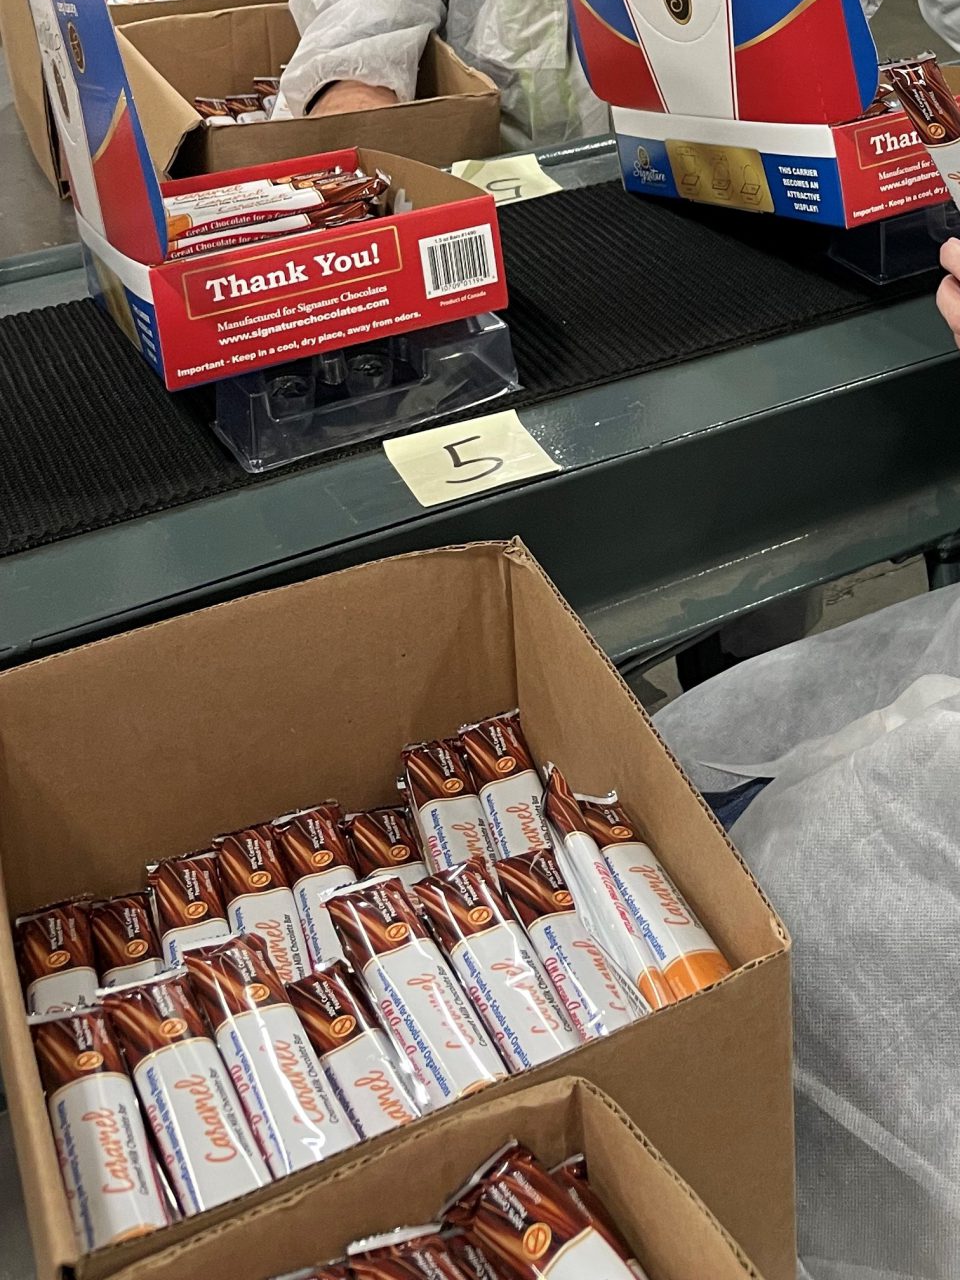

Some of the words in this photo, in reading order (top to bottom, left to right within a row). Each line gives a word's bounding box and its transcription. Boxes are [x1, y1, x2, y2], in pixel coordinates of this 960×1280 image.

[870, 130, 922, 155] Than
[633, 160, 667, 183] Signature
[778, 166, 792, 176] THIS
[792, 167, 818, 178] CARRIER
[782, 179, 810, 188] BECOMES
[810, 180, 819, 189] AN
[878, 164, 921, 180] Manufactured
[921, 161, 930, 169] for
[880, 171, 941, 192] www.signaturec
[786, 190, 821, 202] ATTRACTIVE
[794, 203, 819, 213] DISPLAY!
[853, 204, 885, 218] Important
[888, 198, 905, 208] Keep
[918, 190, 933, 199] cool,
[934, 187, 944, 196] dry
[185, 223, 209, 238] Great
[210, 216, 251, 231] Chocolate
[253, 213, 265, 222] for
[170, 245, 194, 260] Great
[195, 237, 237, 252] Chocolate
[205, 260, 308, 303] Thank
[313, 242, 381, 278] You!
[217, 309, 281, 333] Manufactured
[282, 305, 297, 317] for
[297, 296, 340, 315] Signature
[340, 285, 388, 303] Chocolates
[440, 298, 460, 307] Product
[467, 290, 487, 300] Canada
[219, 297, 390, 346] www.signaturechocolates.com
[177, 358, 226, 378] Important
[231, 353, 257, 365] Keep
[258, 348, 267, 357] in
[268, 347, 276, 355] a
[276, 341, 300, 353] cool,
[300, 336, 317, 348] dry
[317, 329, 346, 344] place,
[347, 325, 372, 336] away
[372, 316, 394, 329] from
[394, 310, 423, 325] odors.
[443, 435, 504, 484] 5
[629, 864, 690, 926] Caramel
[625, 895, 640, 917] Schools
[636, 914, 646, 926] and
[642, 923, 667, 961] Organizations
[255, 919, 290, 982] aramel
[519, 949, 531, 962] Bar
[437, 965, 448, 978] Bar
[312, 980, 328, 1001] Certified
[323, 980, 342, 1010] Peanut-Free
[444, 977, 464, 1006] Chocolate
[543, 989, 557, 1005] Milk
[325, 1002, 337, 1018] 100%
[552, 1004, 573, 1033] Gourmet
[293, 1033, 304, 1046] Bar
[466, 1020, 488, 1047] Gourmet
[298, 1047, 317, 1079] Chocolate
[404, 1013, 421, 1040] Schools
[416, 1037, 428, 1050] and
[423, 1049, 451, 1097] Organizations
[312, 1080, 325, 1097] Milk
[174, 1074, 238, 1163] Caramel
[322, 1097, 340, 1124] Gourmet
[121, 1118, 136, 1149] Chocolate
[82, 1107, 135, 1195] Caramel
[129, 1150, 140, 1166] Milk
[133, 1166, 149, 1196] Gourmet
